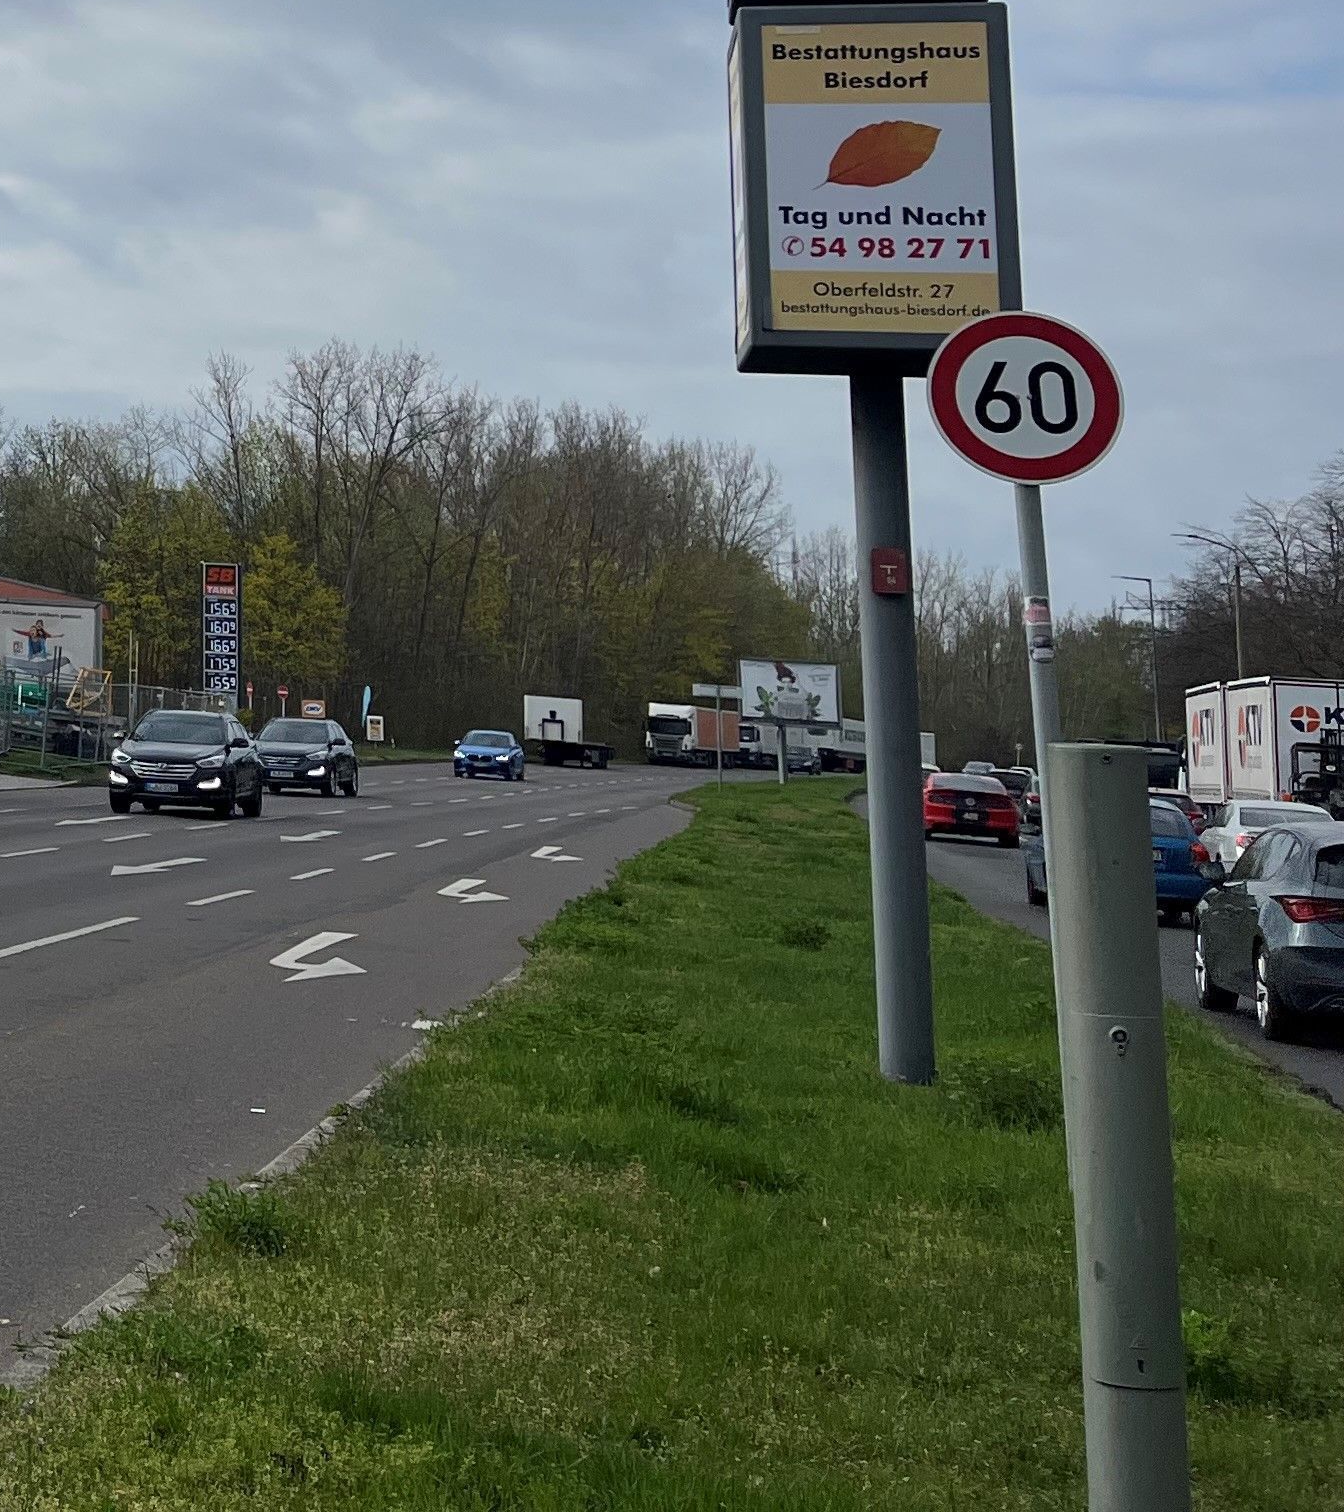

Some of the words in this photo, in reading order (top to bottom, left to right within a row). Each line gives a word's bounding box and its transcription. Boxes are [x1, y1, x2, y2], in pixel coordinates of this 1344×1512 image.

[771, 41, 981, 64] Bestattungshaus
[824, 70, 929, 89] Biesdorf
[778, 205, 828, 230] Tag
[838, 205, 892, 226] und
[902, 206, 987, 227] Nacht
[810, 237, 847, 258] 54
[857, 237, 896, 259] 98
[906, 238, 945, 259] 27
[956, 238, 991, 260] 71
[813, 281, 923, 299] Oberfeldstr.
[930, 284, 954, 299] 27
[781, 300, 991, 317] bestattungshaus-biesdorf.de
[974, 361, 1079, 435] 60
[206, 567, 235, 583] SB
[206, 585, 235, 595] TANK
